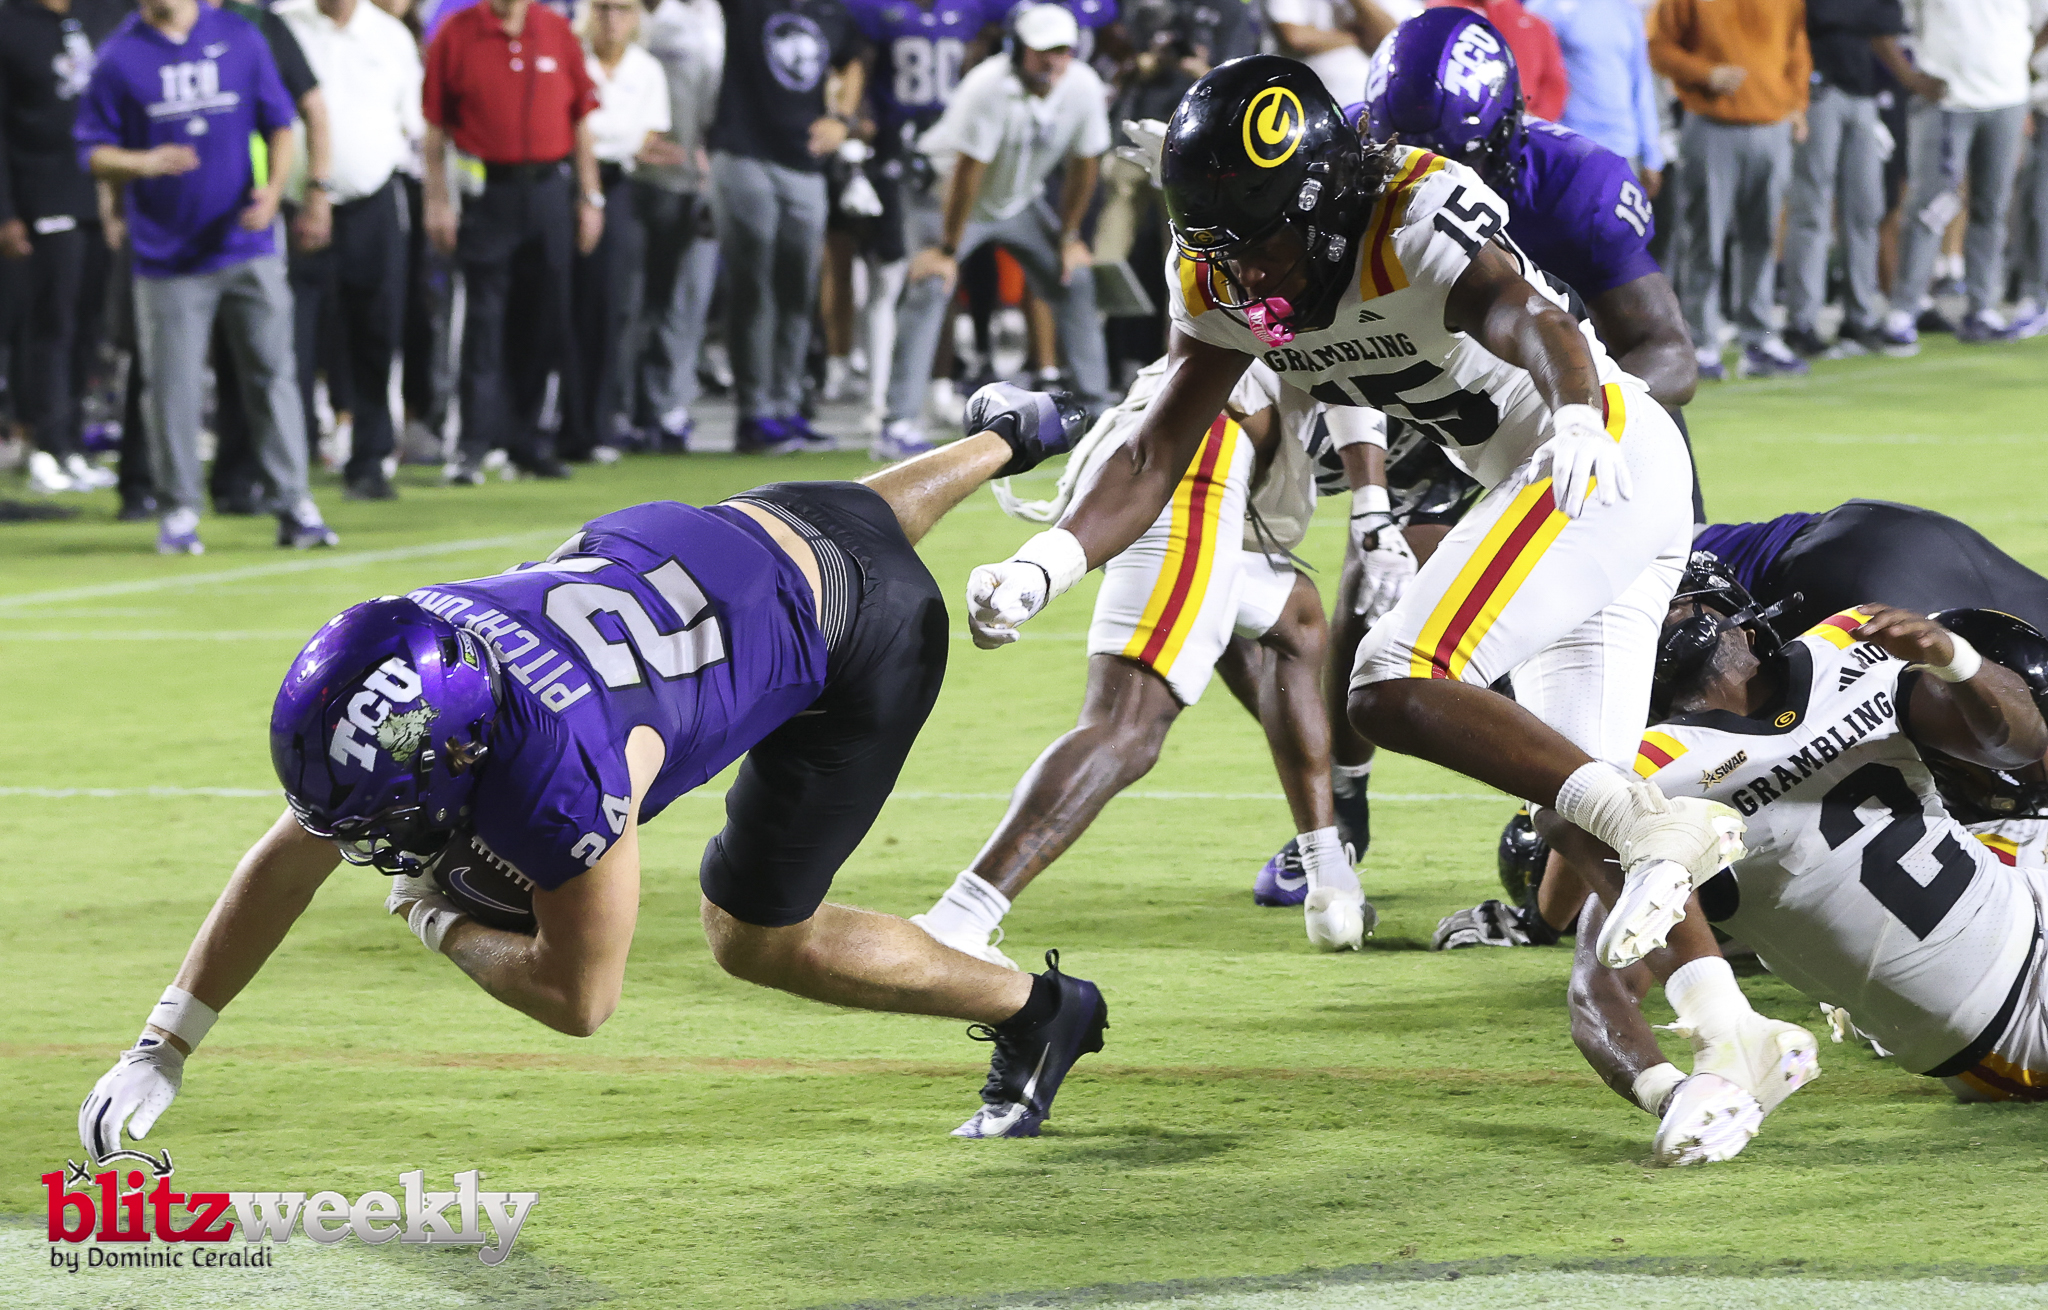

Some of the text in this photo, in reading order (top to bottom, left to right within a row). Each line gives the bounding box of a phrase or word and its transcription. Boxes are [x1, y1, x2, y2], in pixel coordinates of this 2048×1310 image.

[893, 36, 966, 106] 80
[1444, 23, 1500, 102] TCU
[1433, 185, 1501, 261] 15
[1614, 180, 1652, 237] 12
[1264, 333, 1418, 373] GRAMBLING
[329, 657, 423, 772] TCU
[1714, 750, 1748, 779] SWAC
[1732, 692, 1894, 816] GRAMBLING
[570, 792, 631, 868] 24
[1819, 762, 1977, 941] 2
